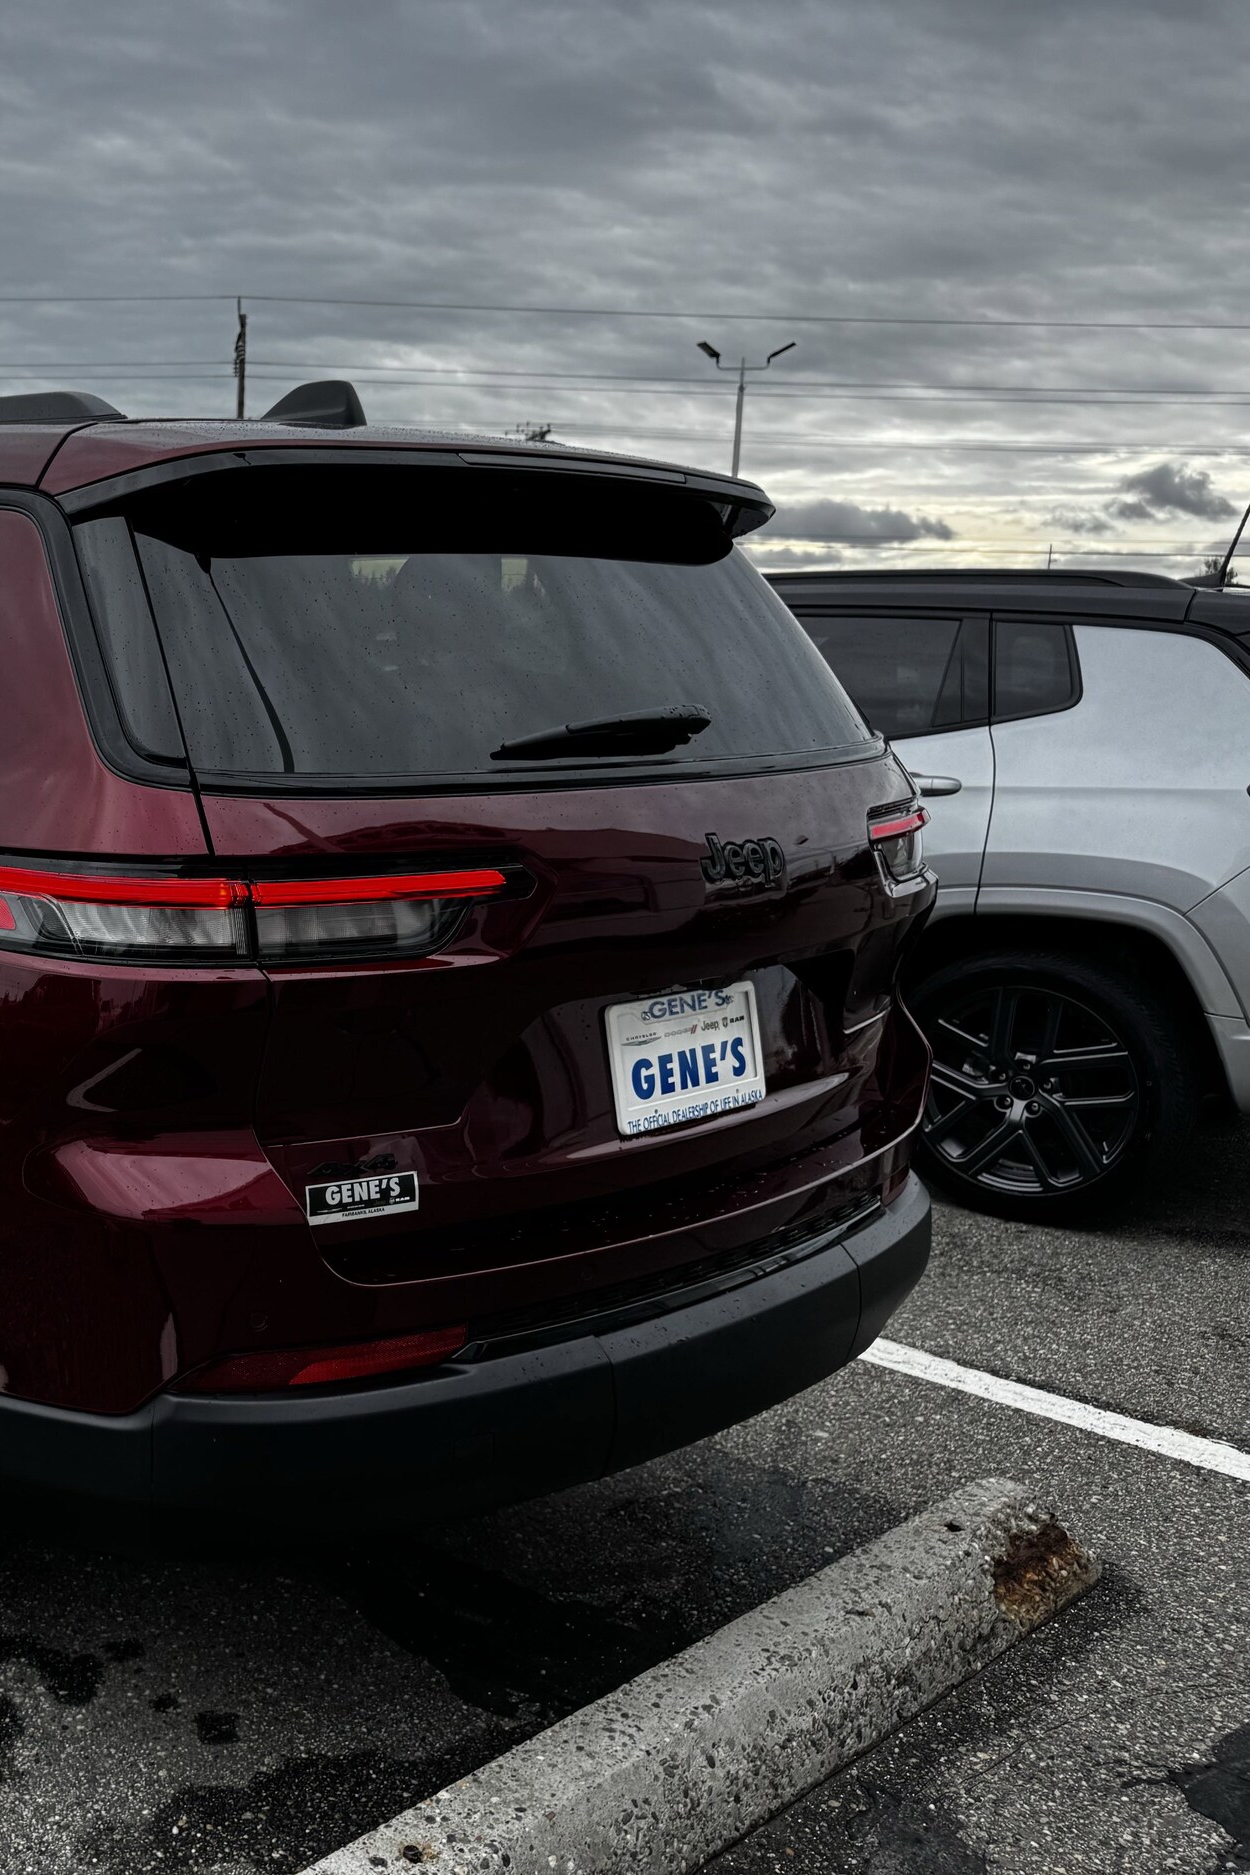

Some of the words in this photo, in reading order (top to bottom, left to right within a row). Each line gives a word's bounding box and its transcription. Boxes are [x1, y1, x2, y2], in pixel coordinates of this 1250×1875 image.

[699, 832, 784, 888] Jeep
[649, 989, 726, 1020] GENE'S
[626, 1032, 657, 1042] CHRYSLER
[700, 1020, 719, 1032] Jeep
[729, 1015, 745, 1024] RAM
[631, 1036, 747, 1100] GENE'S
[628, 1121, 642, 1134] THE
[643, 1113, 671, 1130] OFFICIAL
[672, 1102, 709, 1123] DEALERSHIP
[710, 1100, 720, 1114] OF
[741, 1089, 763, 1105] ALASKA
[325, 1177, 401, 1205] GENE'S
